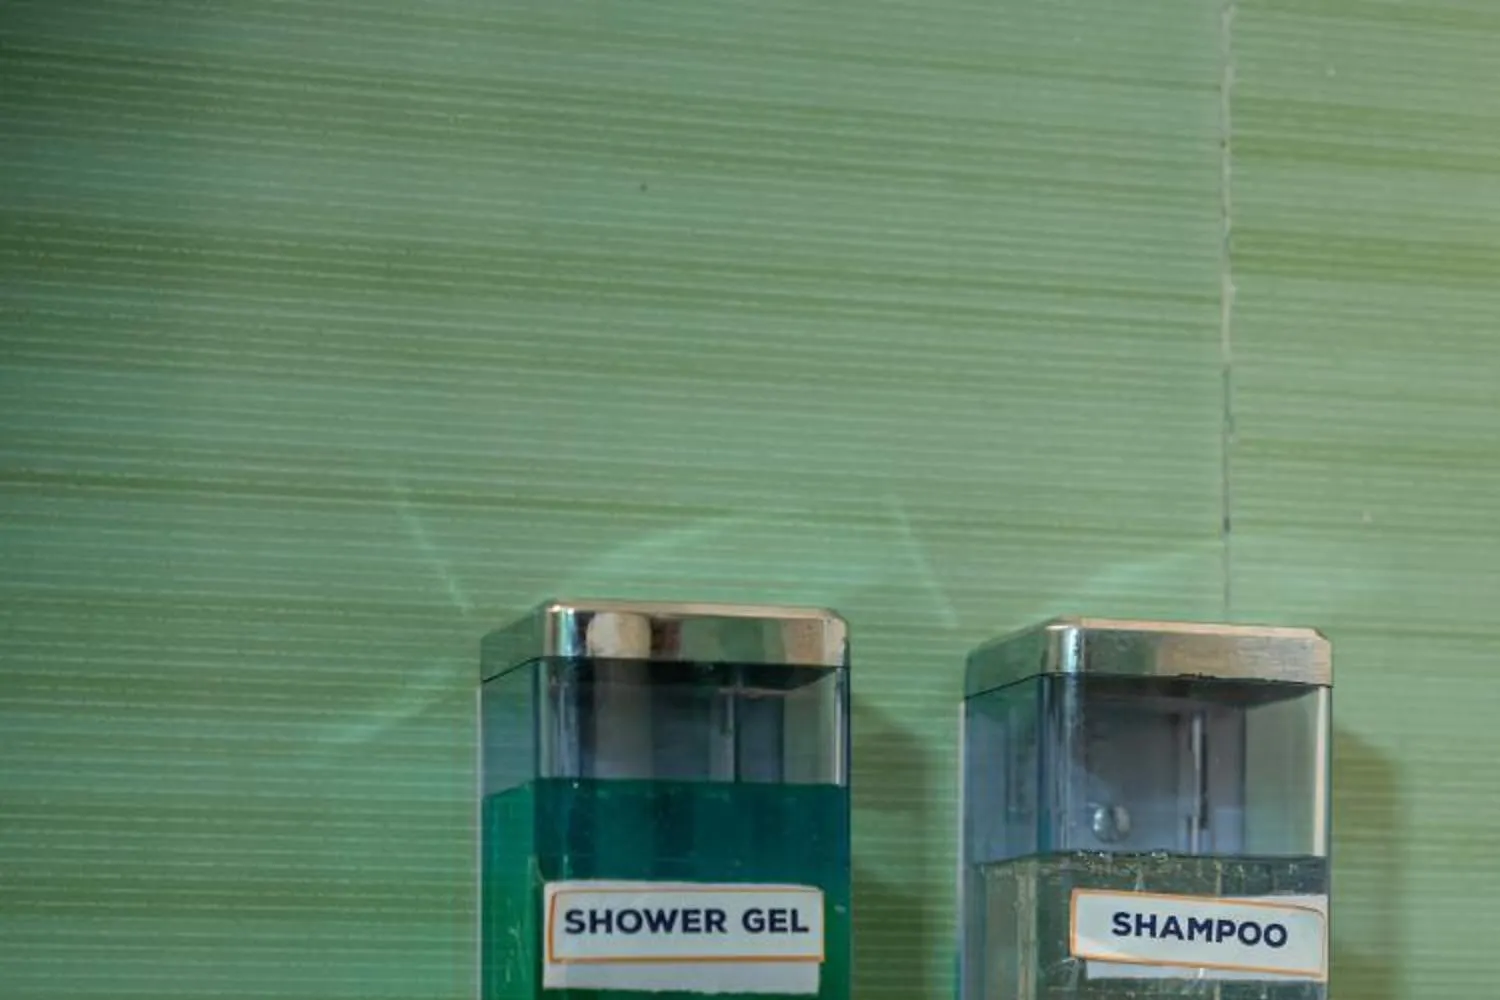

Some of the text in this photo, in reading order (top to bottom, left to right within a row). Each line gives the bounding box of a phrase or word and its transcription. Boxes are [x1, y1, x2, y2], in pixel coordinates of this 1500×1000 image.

[564, 907, 810, 935] SHOWER GEL
[1111, 911, 1289, 949] SHAMPOO
